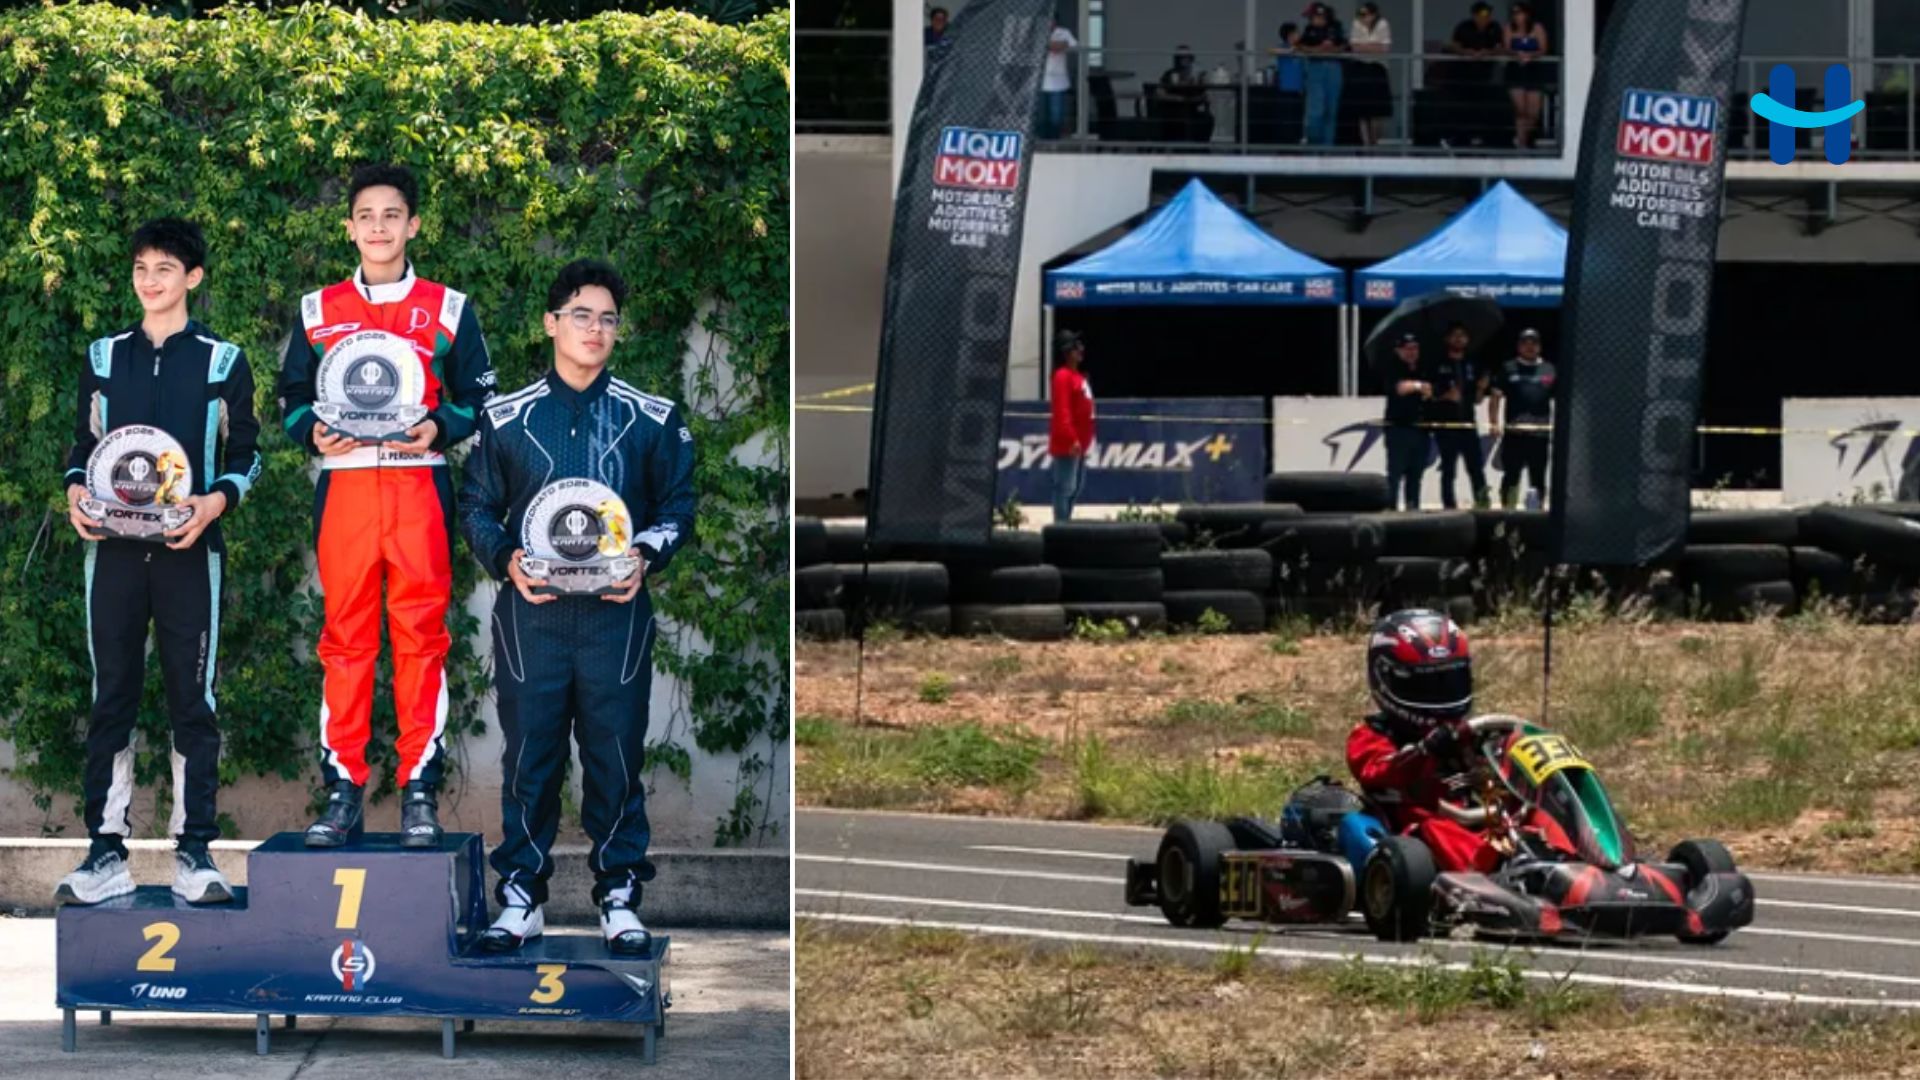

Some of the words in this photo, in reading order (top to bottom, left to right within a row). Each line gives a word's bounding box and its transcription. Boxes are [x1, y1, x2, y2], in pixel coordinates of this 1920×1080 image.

[1627, 92, 1711, 128] LIQUI
[944, 130, 1017, 159] LIQUI
[1623, 124, 1710, 159] MOLY
[940, 157, 1015, 185] MOLY
[1614, 161, 1671, 178] MOTOR
[931, 188, 979, 205] MOTOR
[1617, 178, 1702, 200] ADDITIVES
[935, 203, 1007, 220] ADDITIVES
[1609, 193, 1706, 218] MOTORBIKE
[928, 216, 1010, 236] MOTORBIKE
[1637, 211, 1680, 230] CARE
[950, 232, 987, 248] CARE
[356, 333, 386, 341] 2026
[339, 411, 398, 422] VORTEX
[125, 427, 155, 436] 2026
[558, 481, 590, 490] 2026
[105, 508, 162, 522] VORTEX
[548, 566, 609, 577] VORTEX
[333, 868, 367, 929] 1
[136, 922, 181, 972] 2
[148, 986, 188, 999] UNO
[529, 964, 567, 1004] 3
[305, 993, 361, 1003] KARTING
[364, 995, 403, 1005] CLUB
